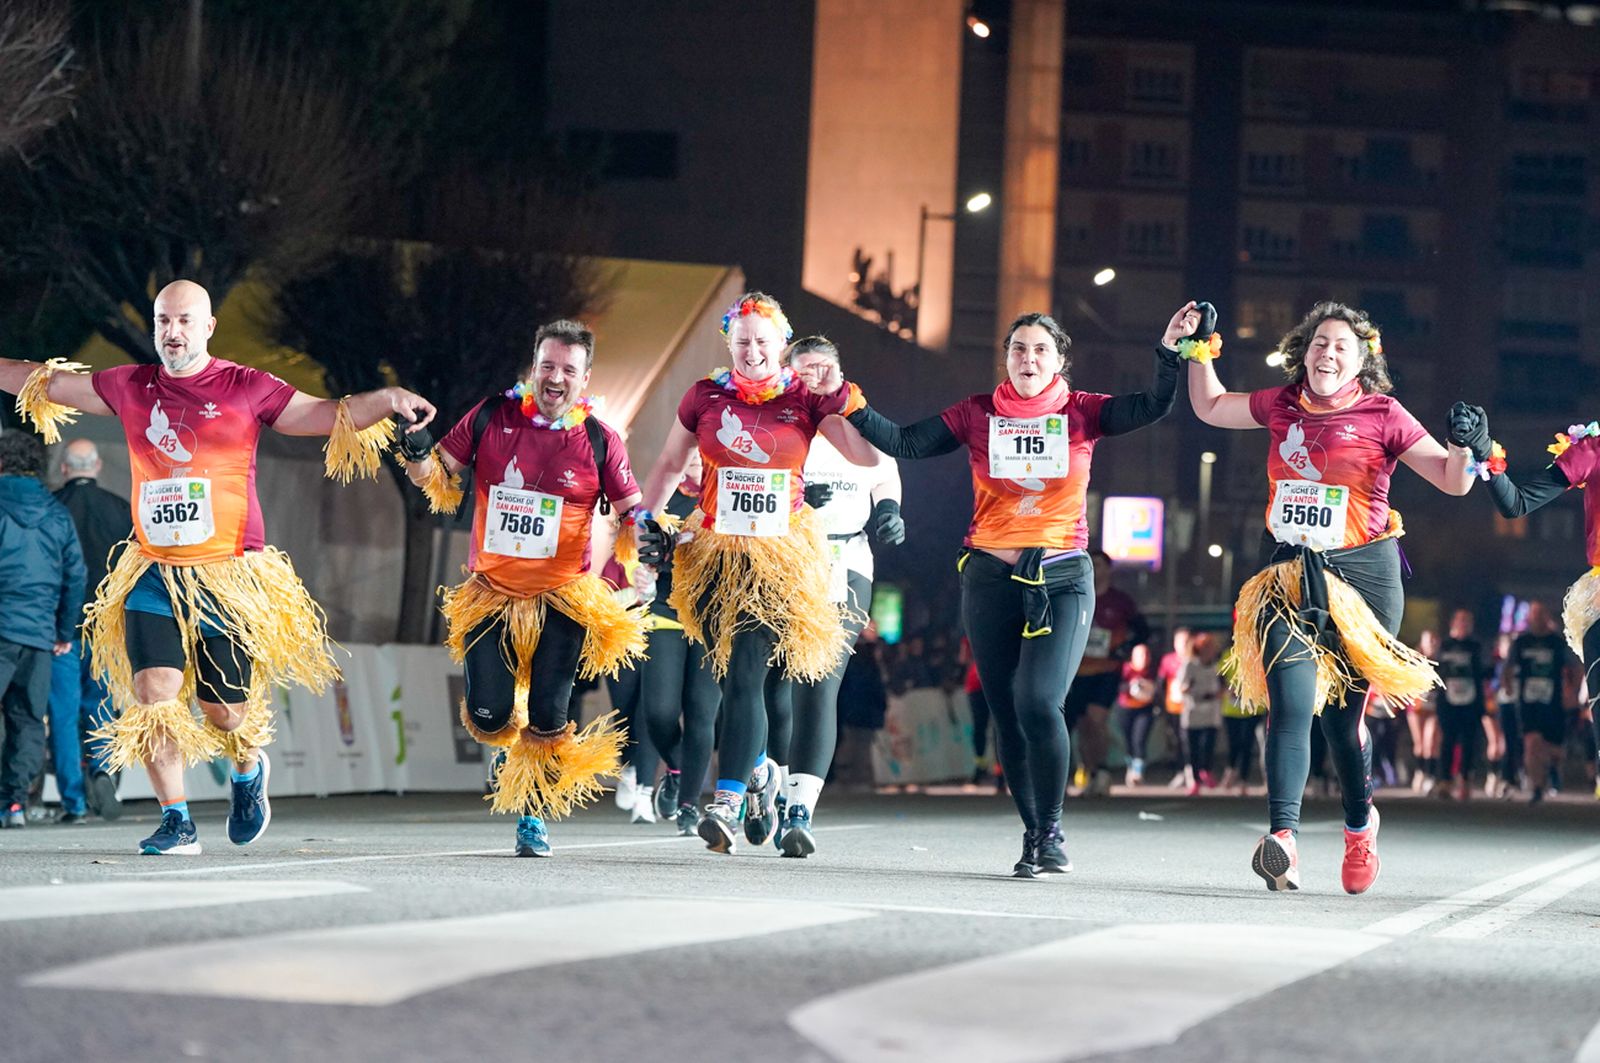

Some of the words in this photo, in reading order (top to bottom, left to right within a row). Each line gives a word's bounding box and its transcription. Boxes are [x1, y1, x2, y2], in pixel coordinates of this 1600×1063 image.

[998, 428, 1014, 436] SAN
[158, 434, 177, 453] 43
[730, 435, 753, 454] 43
[1013, 436, 1045, 454] 115
[1288, 451, 1307, 470] 43
[726, 482, 740, 490] SAN
[734, 475, 755, 483] NOCHE
[174, 485, 182, 493] DE
[496, 502, 509, 511] SAN
[504, 495, 525, 504] NOCHE
[731, 491, 777, 514] 7666
[151, 502, 199, 524] 5562
[1282, 503, 1333, 528] 5560
[500, 512, 545, 537] 7586
